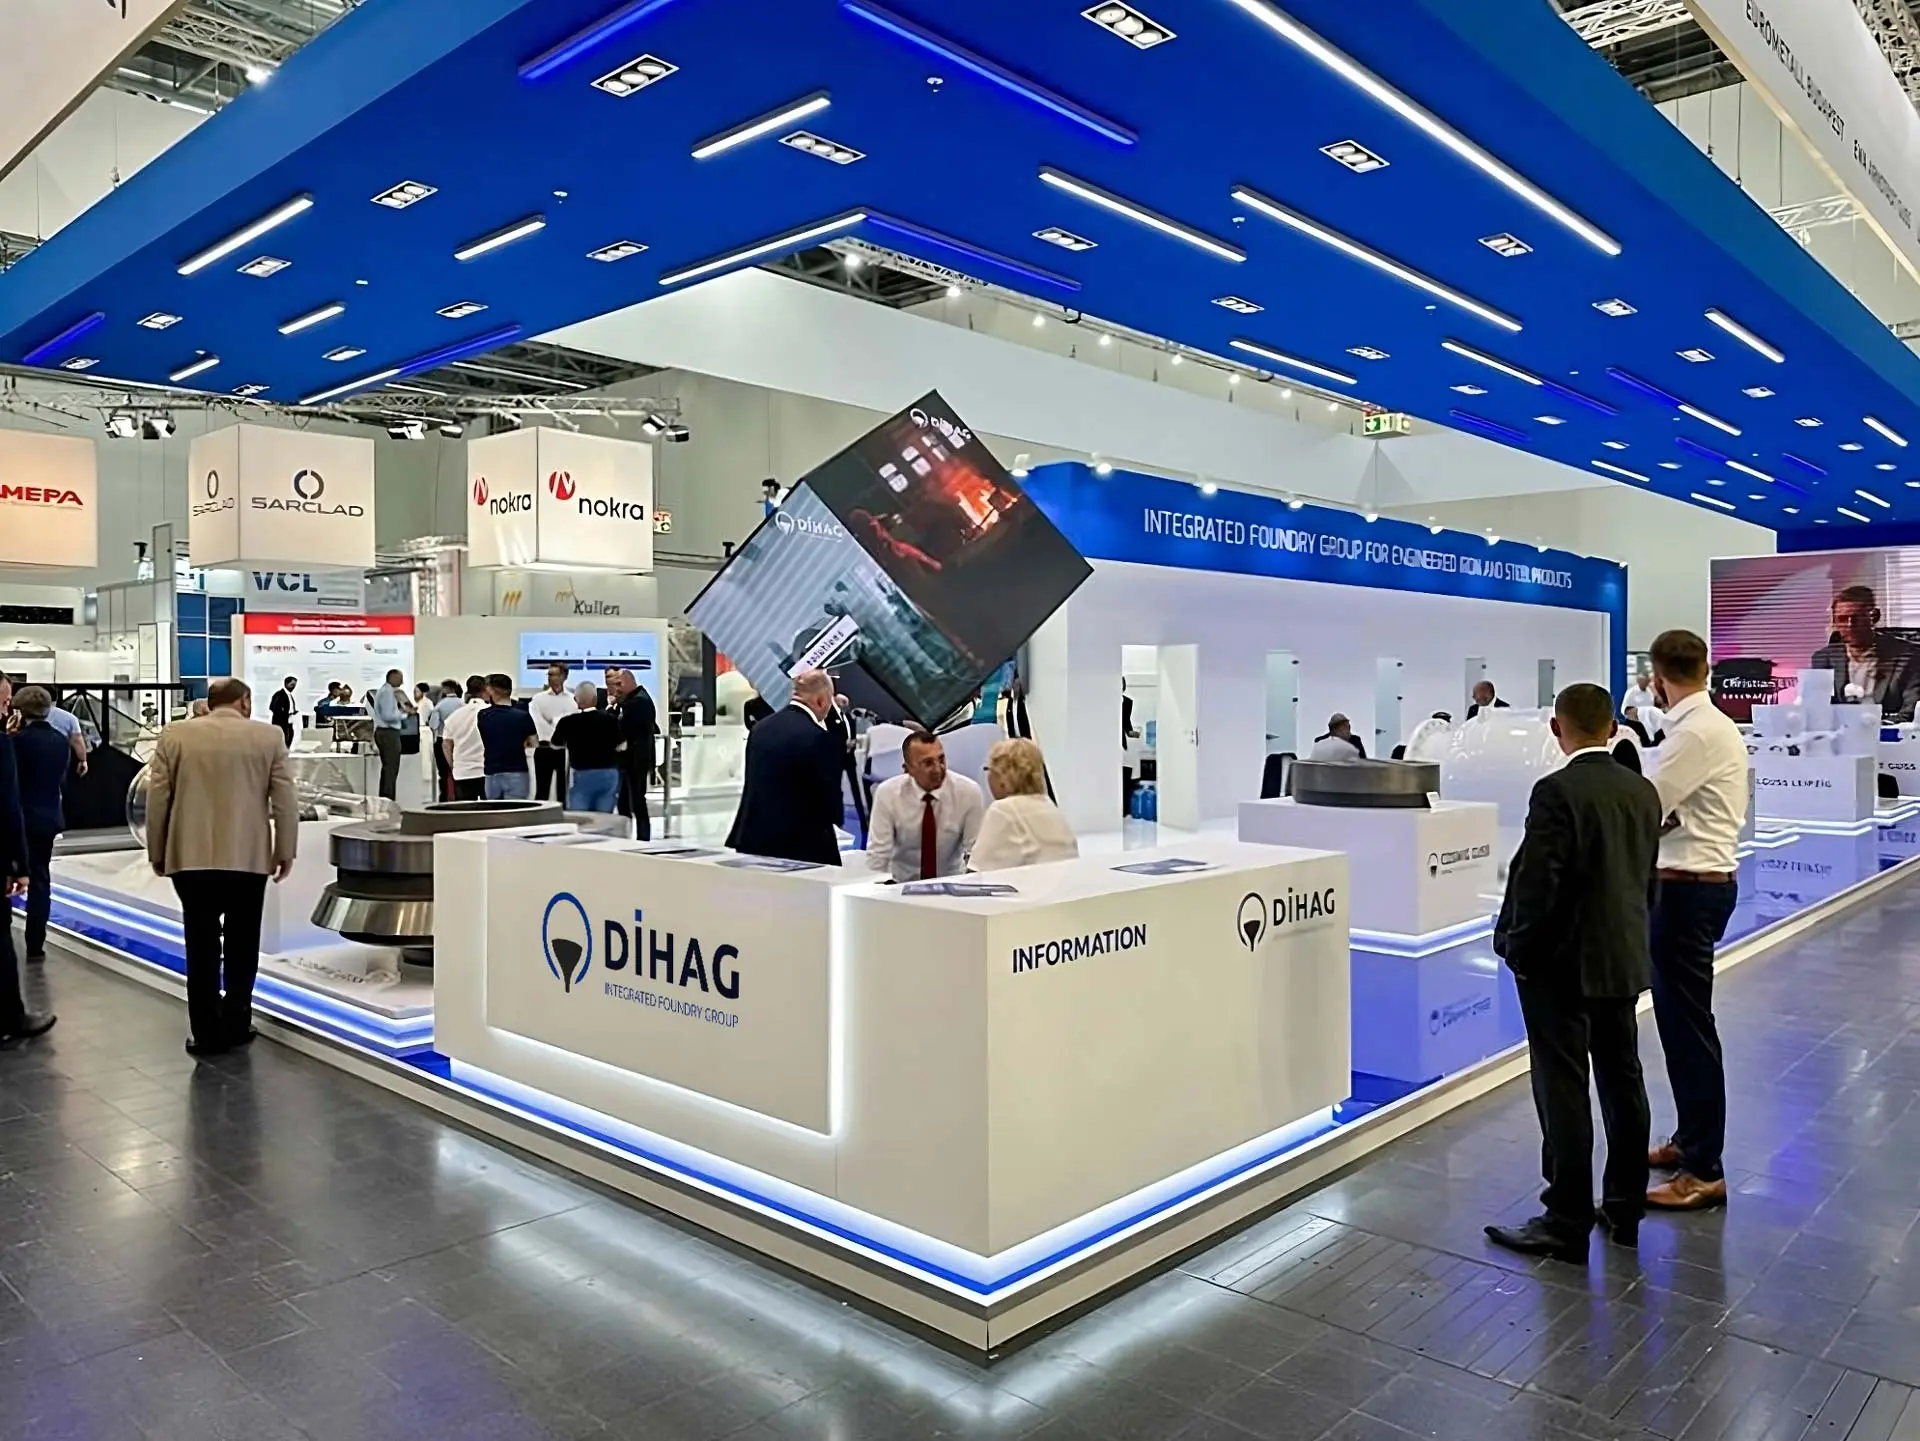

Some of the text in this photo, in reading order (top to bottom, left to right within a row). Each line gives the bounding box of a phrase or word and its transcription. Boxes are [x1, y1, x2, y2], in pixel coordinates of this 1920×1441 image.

[251, 496, 365, 518] SARCLAD
[490, 491, 532, 515] nokra
[578, 496, 644, 521] nokra
[1144, 508, 1246, 546] INTEGRATED
[1249, 523, 1317, 555] FOUNDRY
[1319, 533, 1363, 560] GROUP
[1365, 540, 1389, 564] FOR
[573, 599, 621, 616] Kullen
[1012, 923, 1147, 974] INFORMATION
[604, 982, 740, 1029] INTEGRATED FOUNDRY GROUP
